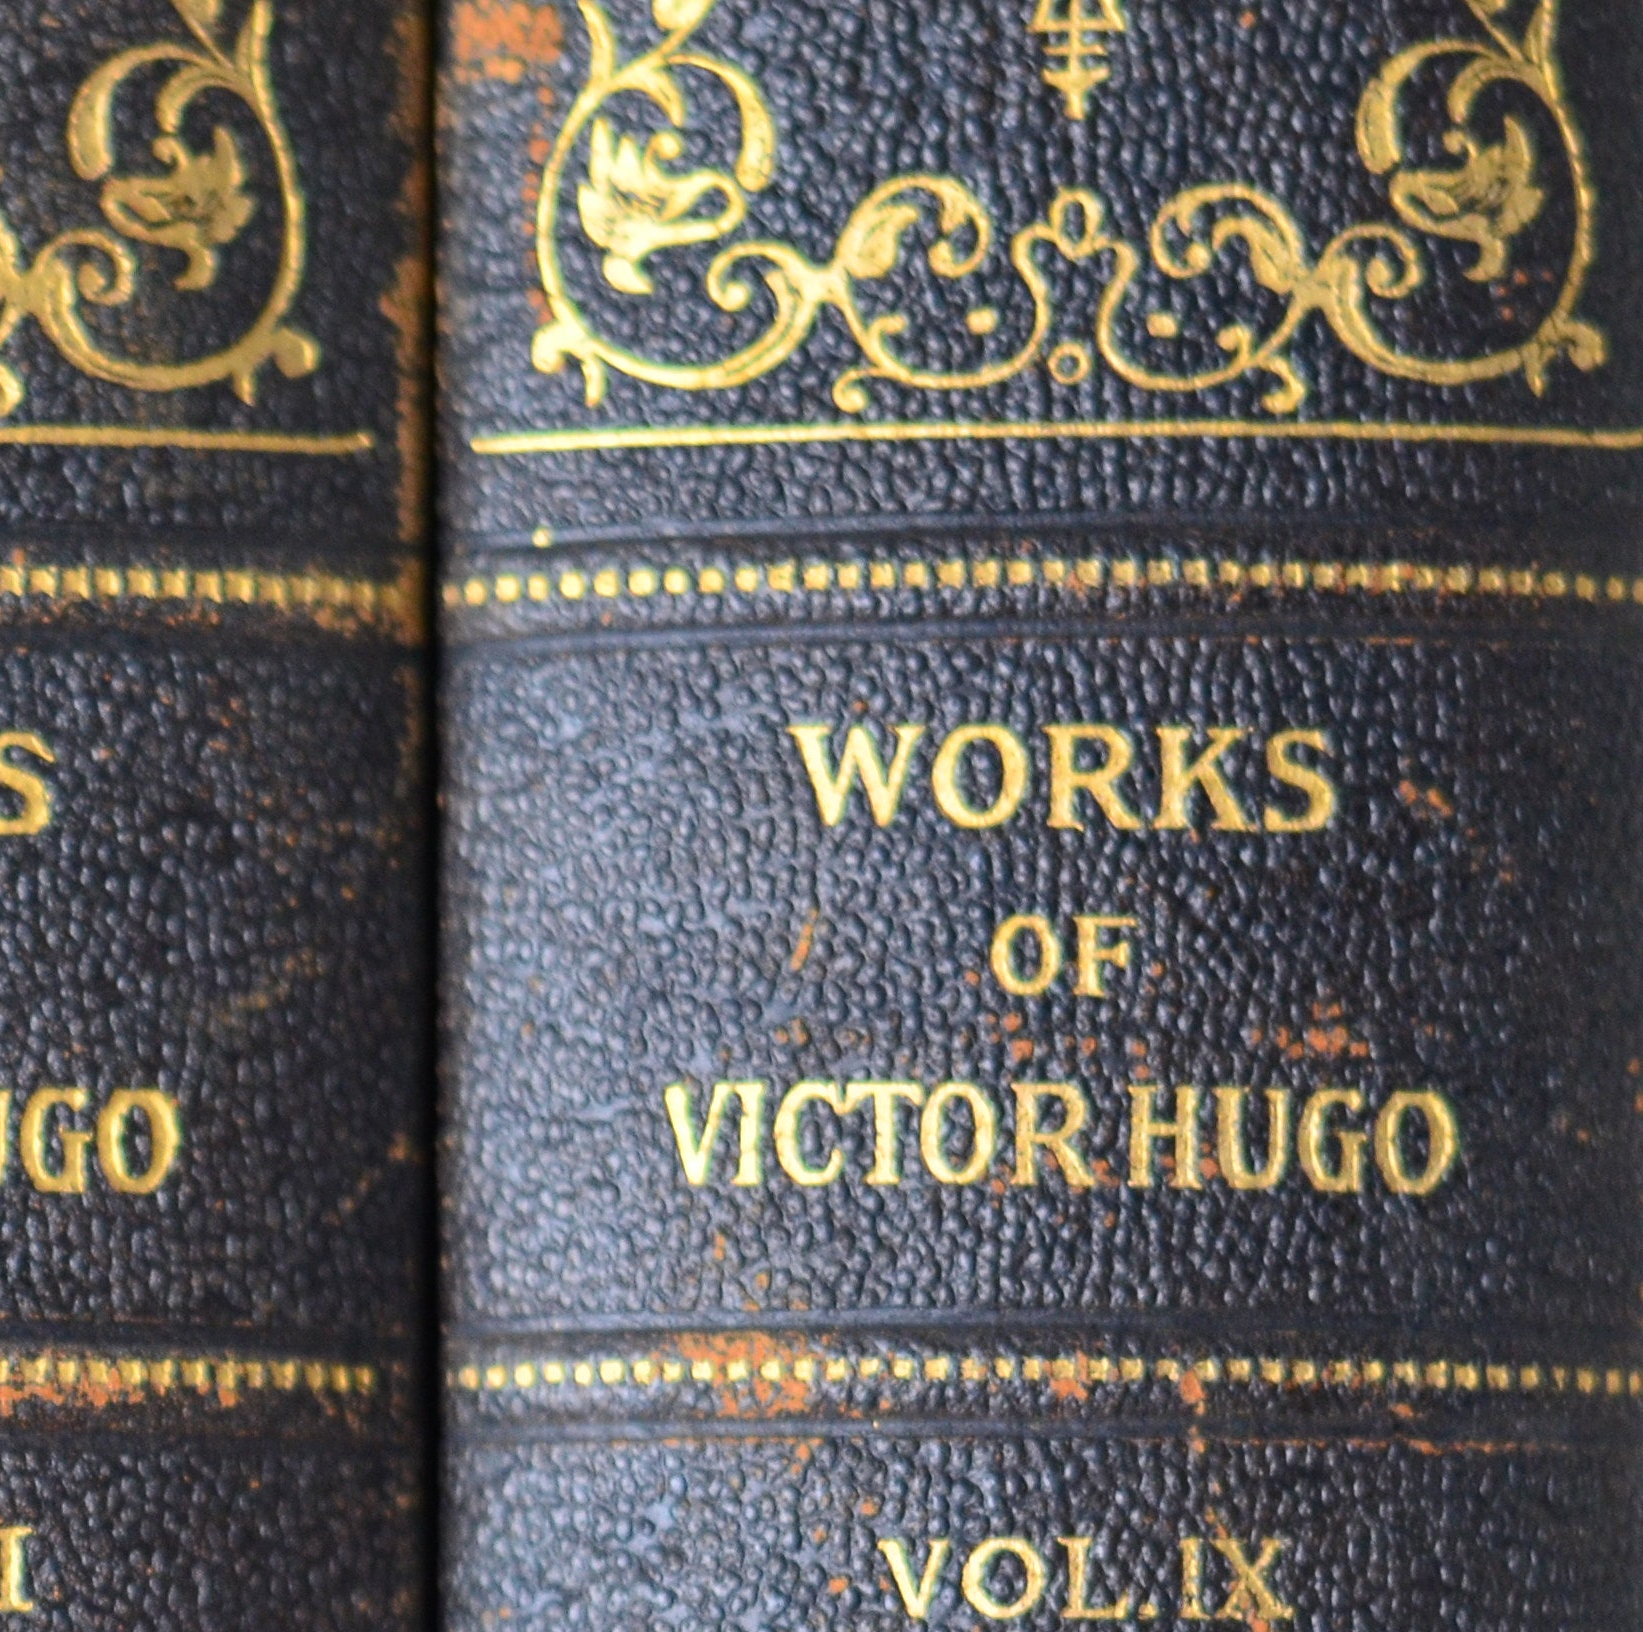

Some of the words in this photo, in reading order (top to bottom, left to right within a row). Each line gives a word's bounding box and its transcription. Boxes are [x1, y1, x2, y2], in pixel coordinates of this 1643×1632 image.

[789, 724, 1338, 831] WORKS
[989, 914, 1139, 997] OF
[665, 1081, 1095, 1188] VICTOR
[1129, 1085, 1459, 1194] HUGO
